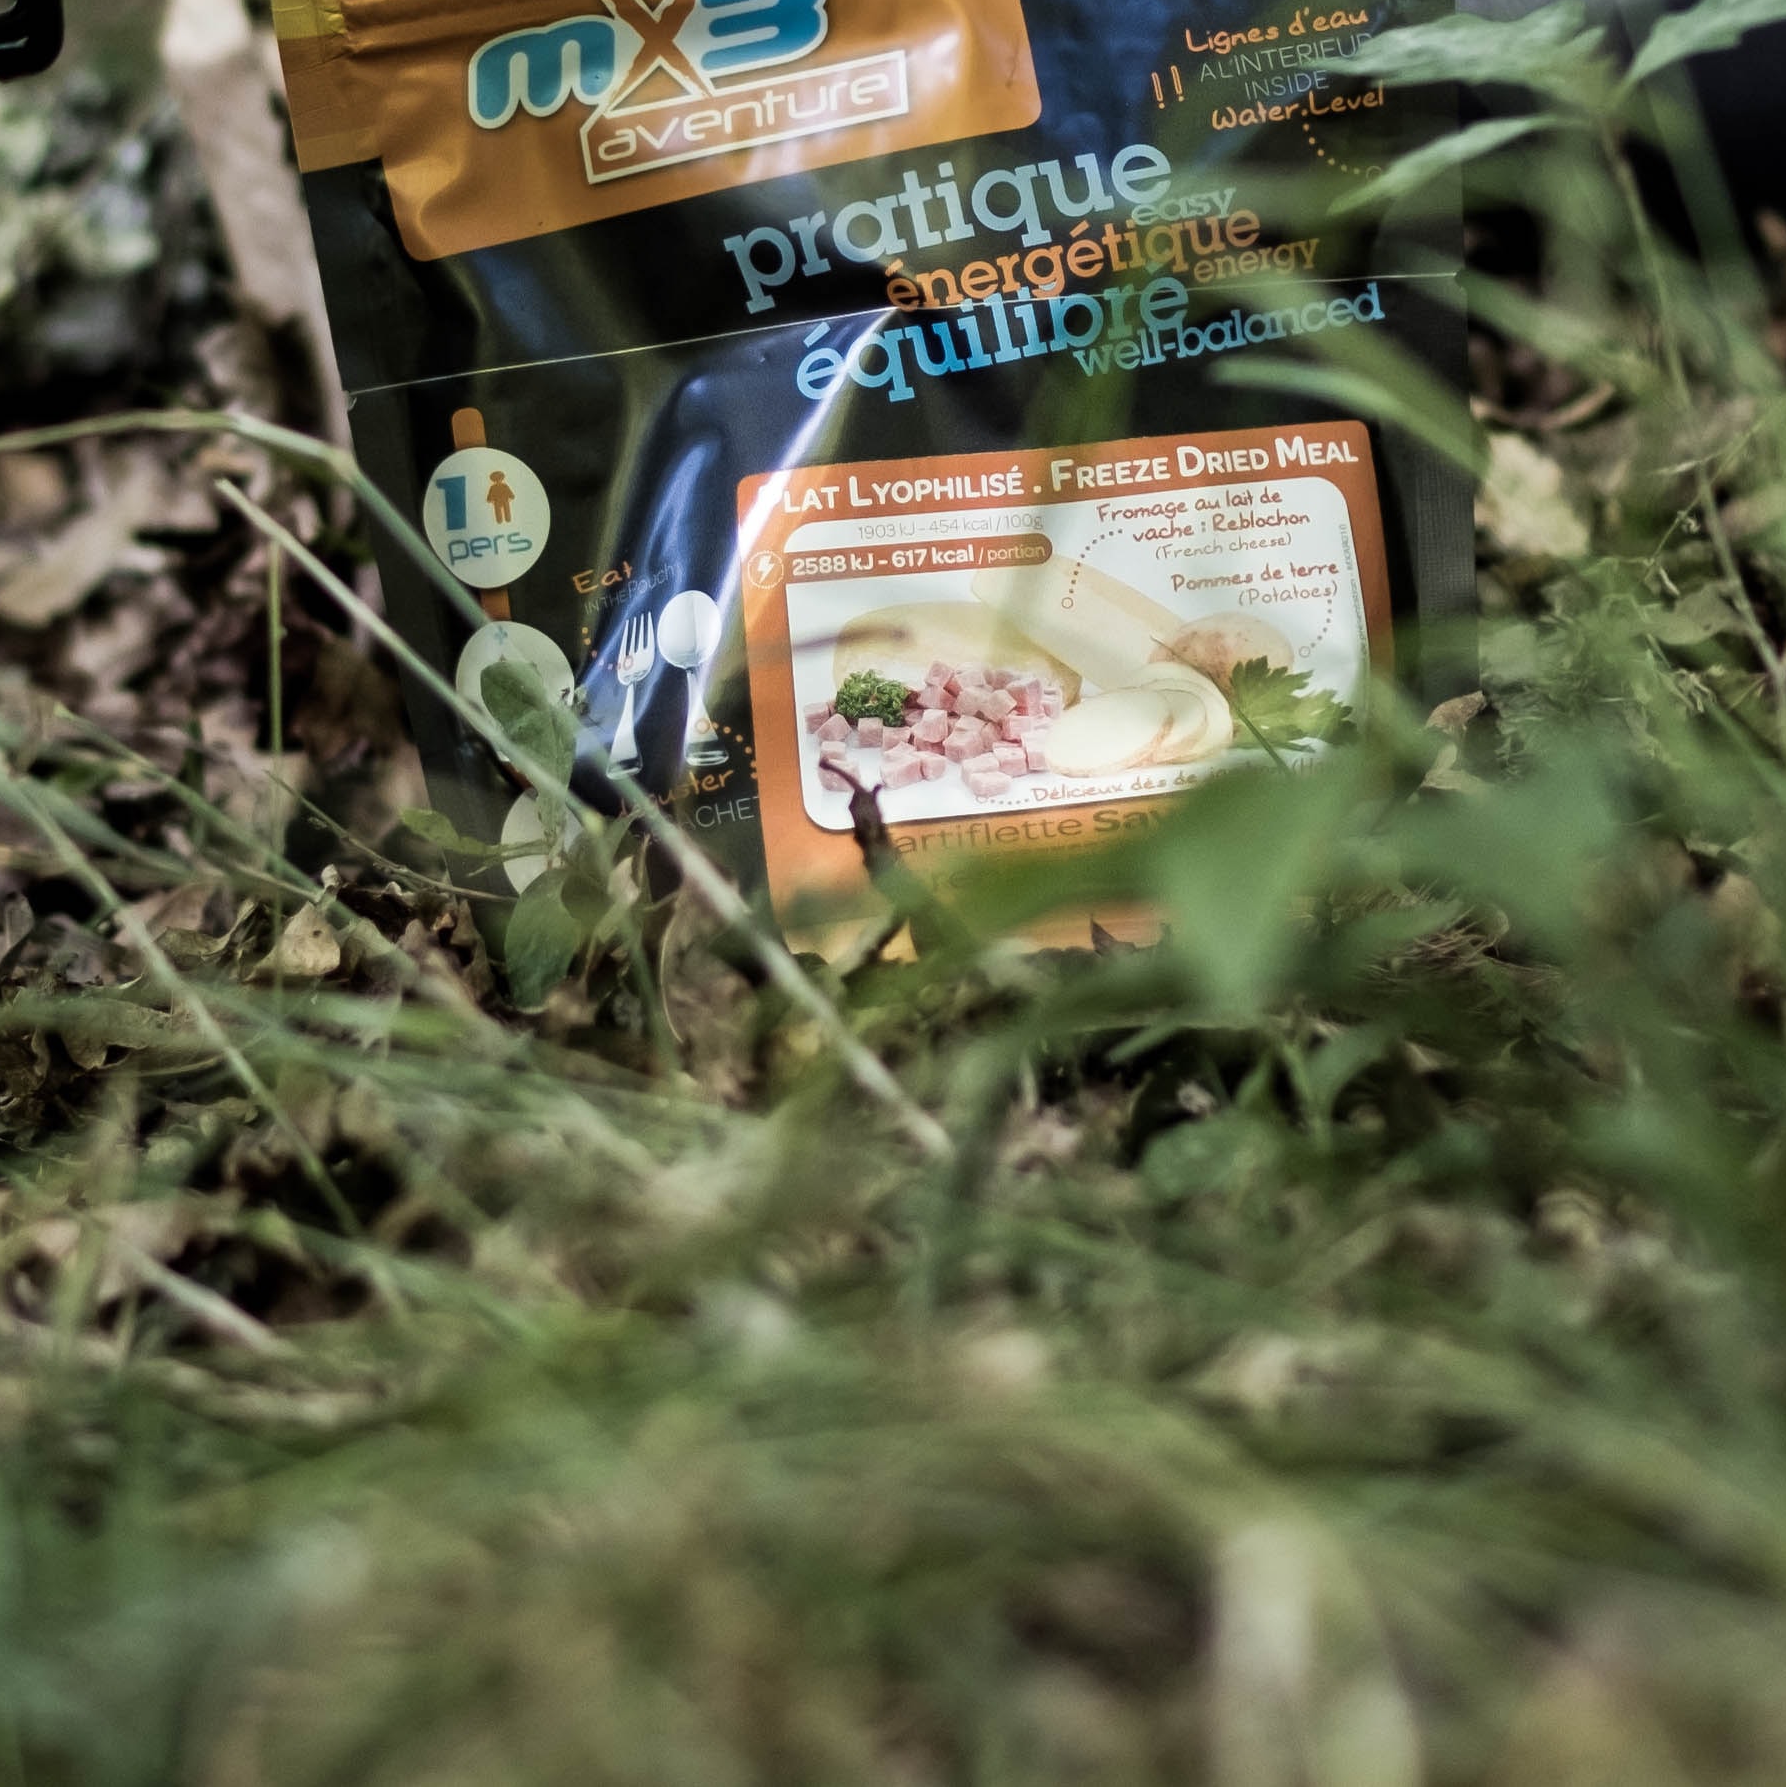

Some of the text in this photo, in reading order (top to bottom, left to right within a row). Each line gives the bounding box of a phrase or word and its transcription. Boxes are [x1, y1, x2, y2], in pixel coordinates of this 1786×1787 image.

[1185, 7, 1369, 55] Lignes d'eau
[1244, 70, 1331, 100] INSIDE
[598, 72, 891, 161] aventure
[1211, 80, 1385, 130] Water Level
[1131, 188, 1237, 226] easy
[723, 144, 1172, 314] pratique
[886, 209, 1261, 312] énergétique
[1192, 238, 1320, 284] energy
[1072, 282, 1386, 377] well-balanced
[435, 475, 467, 531] 1
[760, 482, 841, 514] LAT
[1096, 487, 1283, 523] Fromage au lait de
[858, 524, 896, 540] 1903
[929, 518, 959, 534] 454
[963, 515, 993, 532] kcal
[1132, 520, 1195, 542] vache
[1212, 509, 1310, 533] Reblochon
[448, 532, 533, 566] pers
[791, 554, 848, 577] 2588
[850, 552, 874, 571] kJ
[891, 548, 928, 569] 617
[931, 544, 975, 565] kcal
[987, 544, 1046, 564] portion
[1155, 532, 1292, 560] (French cheese)
[572, 560, 633, 595] Eat
[1170, 561, 1340, 593] Pommes de terre
[1238, 580, 1339, 607] (Potatoes)
[893, 816, 1084, 855] artiflette
